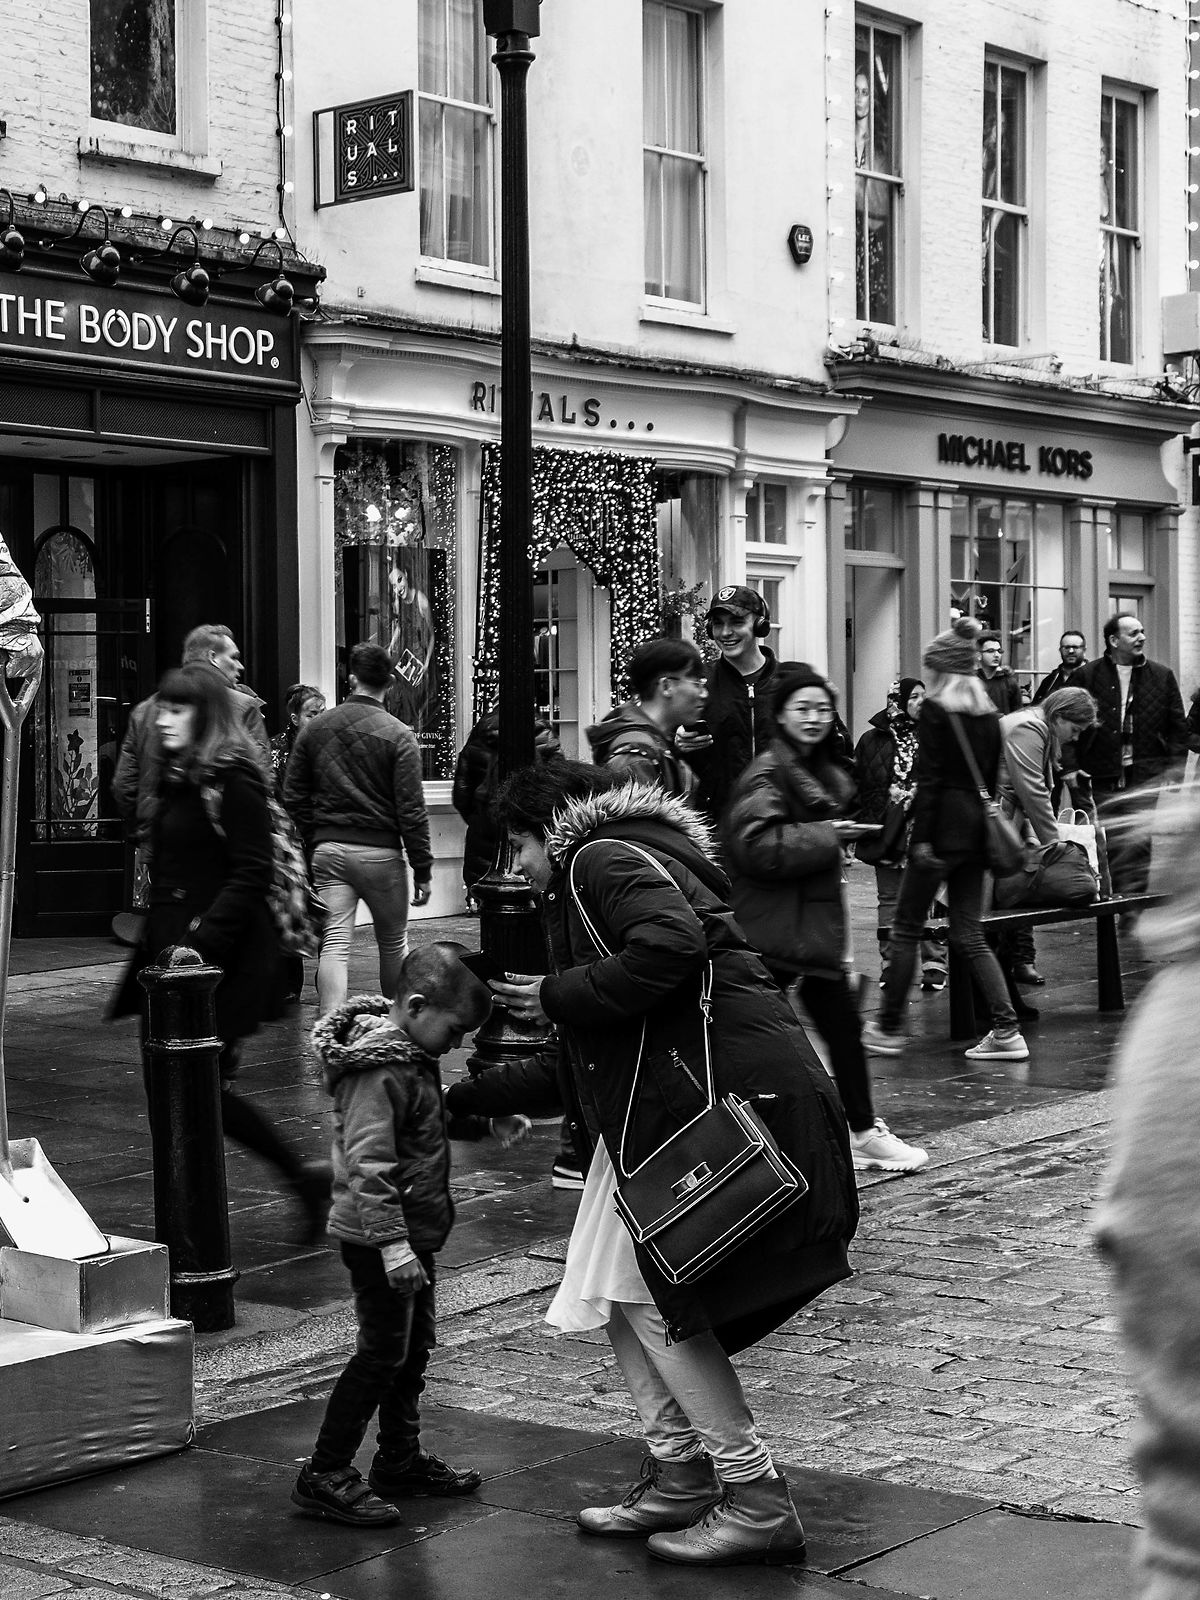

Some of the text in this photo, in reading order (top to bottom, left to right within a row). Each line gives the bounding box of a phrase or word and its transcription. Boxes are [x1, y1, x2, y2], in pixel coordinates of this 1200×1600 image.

[79, 303, 178, 353] BODY
[185, 319, 275, 366] SHOP
[472, 381, 654, 432] RIALS...
[938, 432, 1094, 481] MICHAEL KORS
